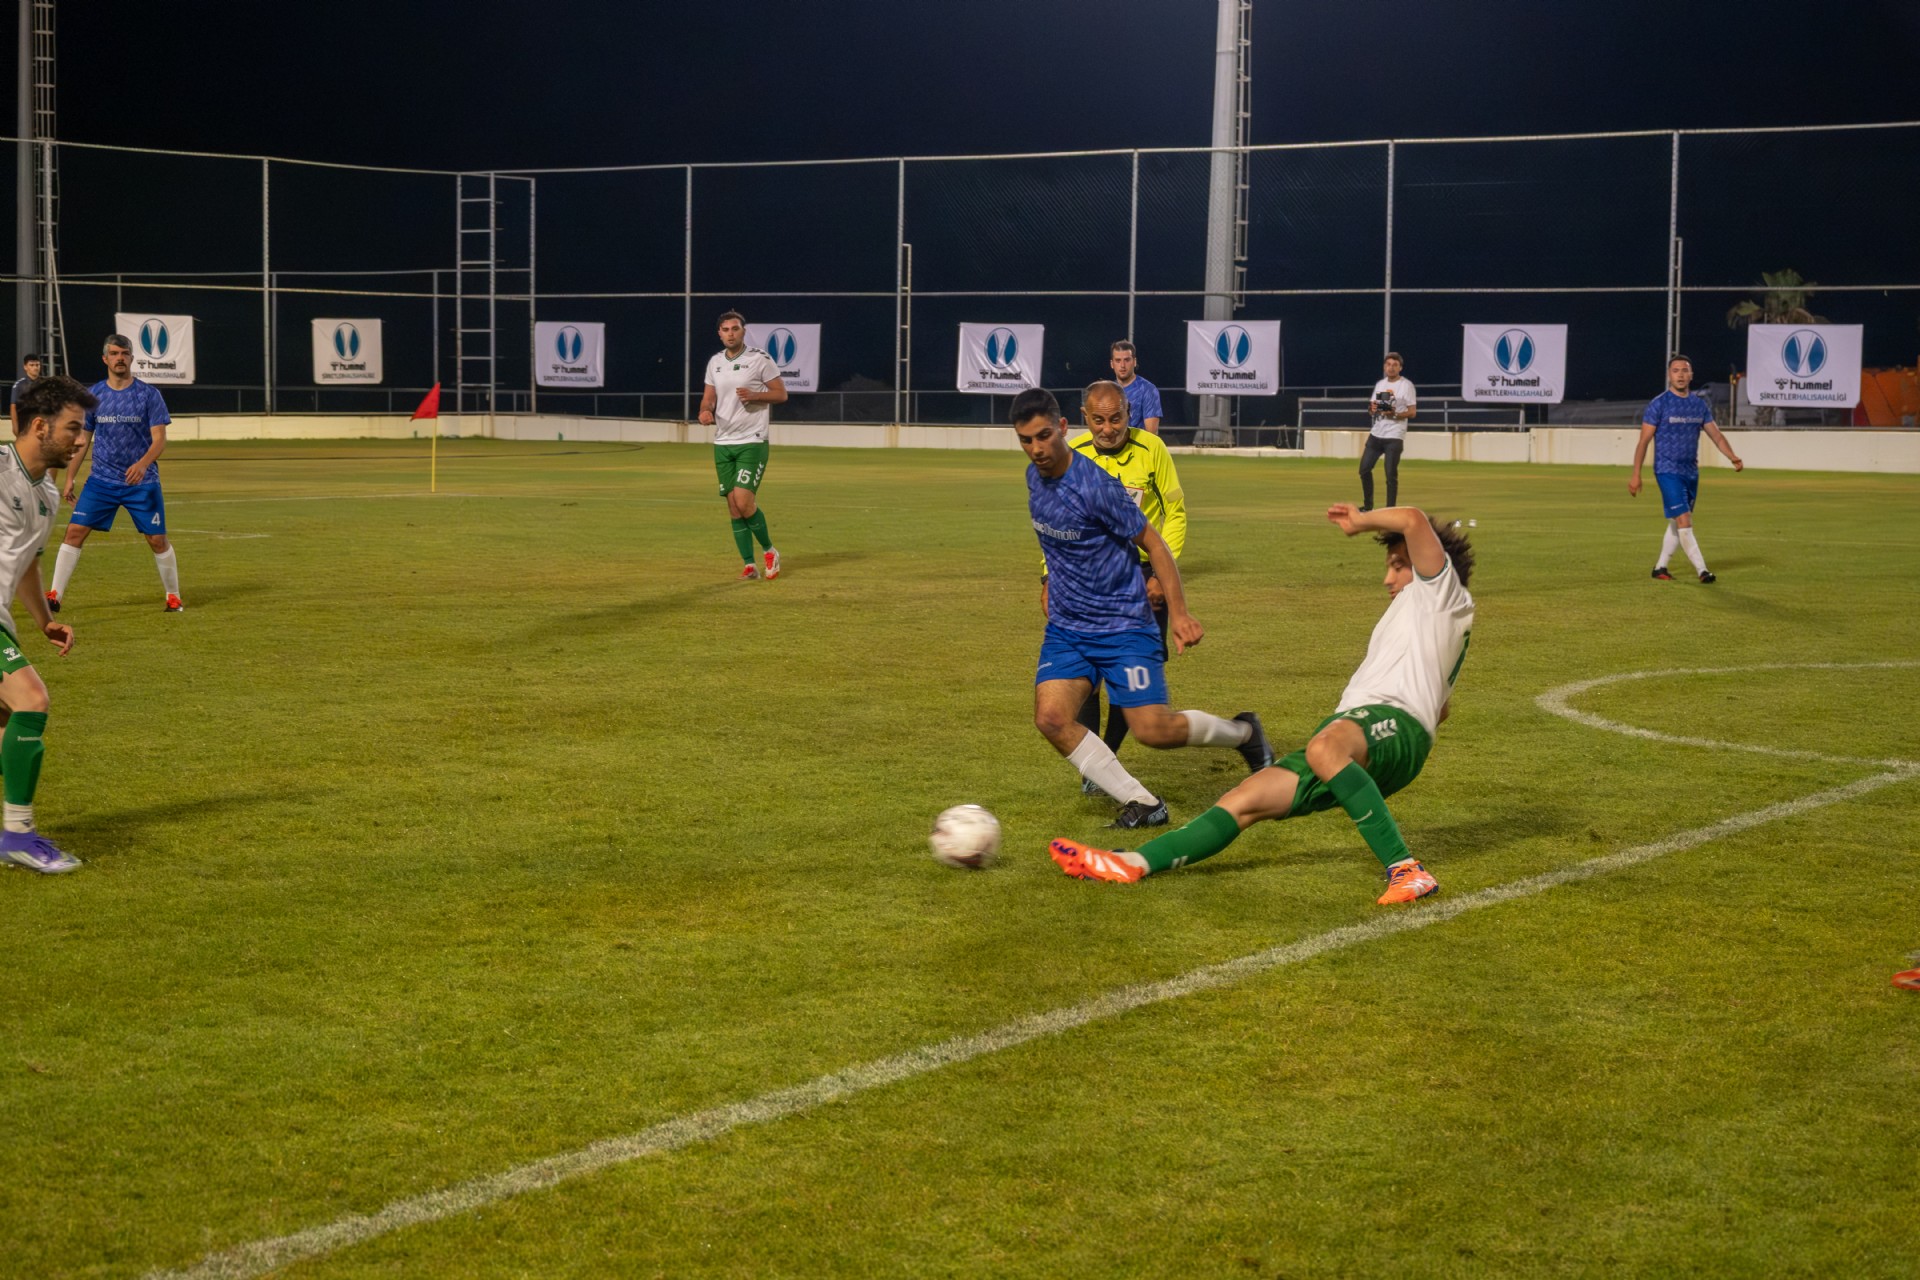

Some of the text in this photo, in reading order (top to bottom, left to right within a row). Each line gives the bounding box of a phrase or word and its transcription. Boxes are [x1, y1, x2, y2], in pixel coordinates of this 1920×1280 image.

[779, 368, 801, 378] mmel
[1221, 370, 1256, 380] hummel
[1501, 376, 1540, 387] hummel
[1789, 379, 1833, 391] hummel
[736, 468, 752, 484] 15
[151, 512, 161, 526] 4
[1124, 665, 1151, 692] 10
